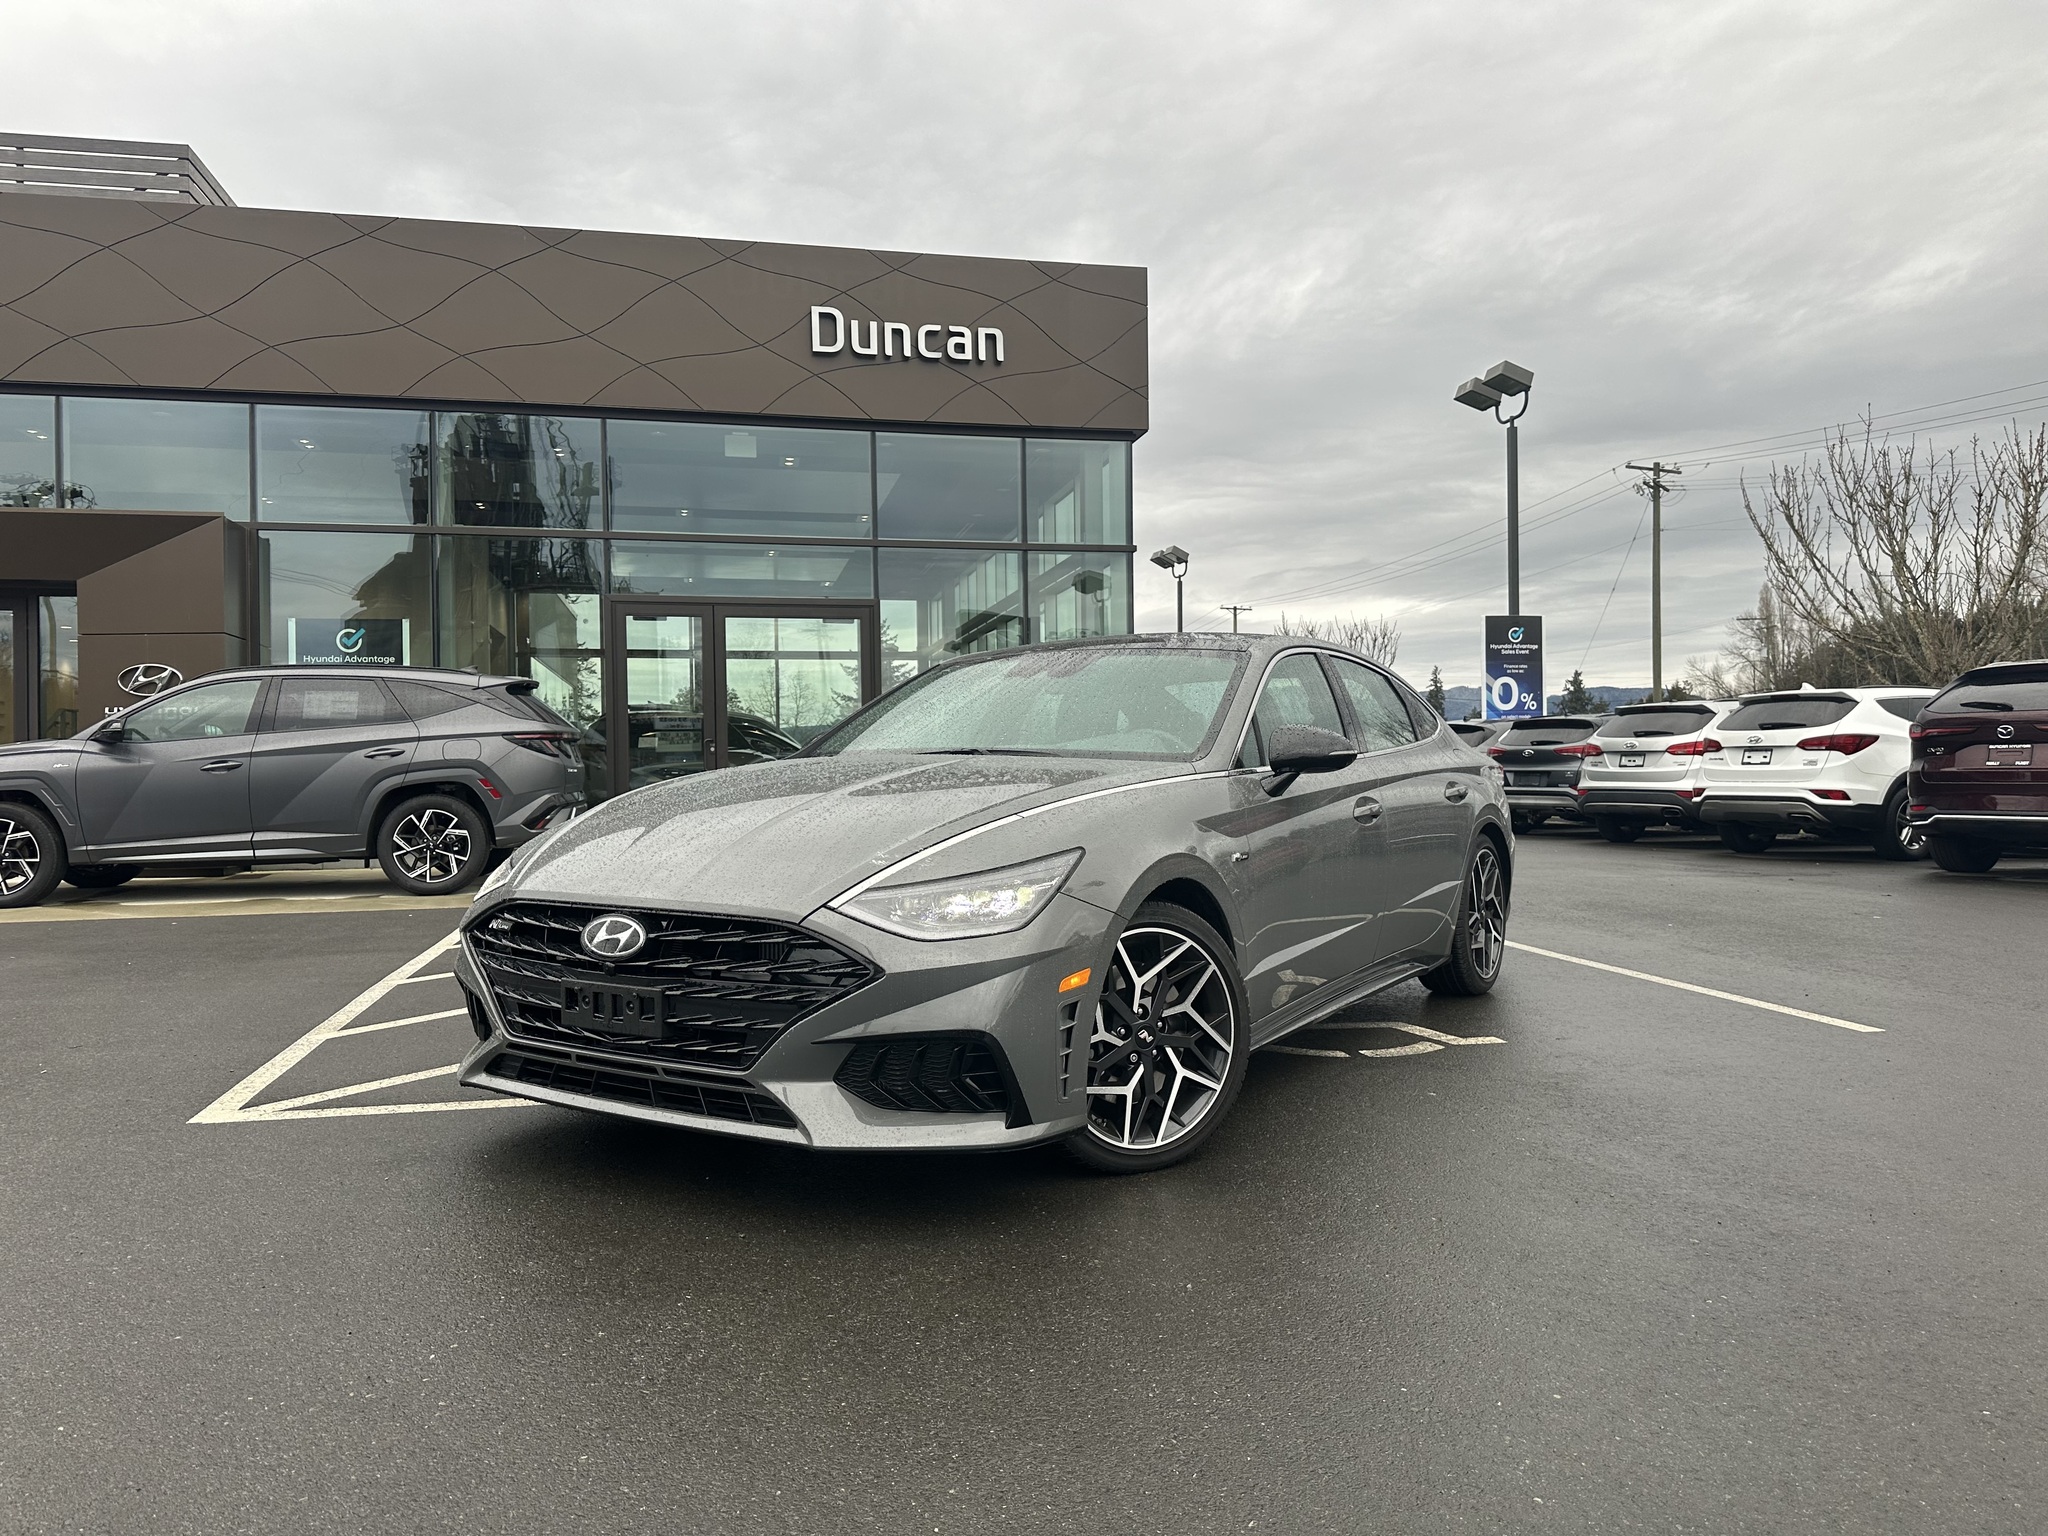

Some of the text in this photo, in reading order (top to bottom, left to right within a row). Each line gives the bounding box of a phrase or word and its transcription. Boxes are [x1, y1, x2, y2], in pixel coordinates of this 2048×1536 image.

[810, 305, 1005, 362] Duncan
[303, 655, 395, 665] Hyundai Advantage
